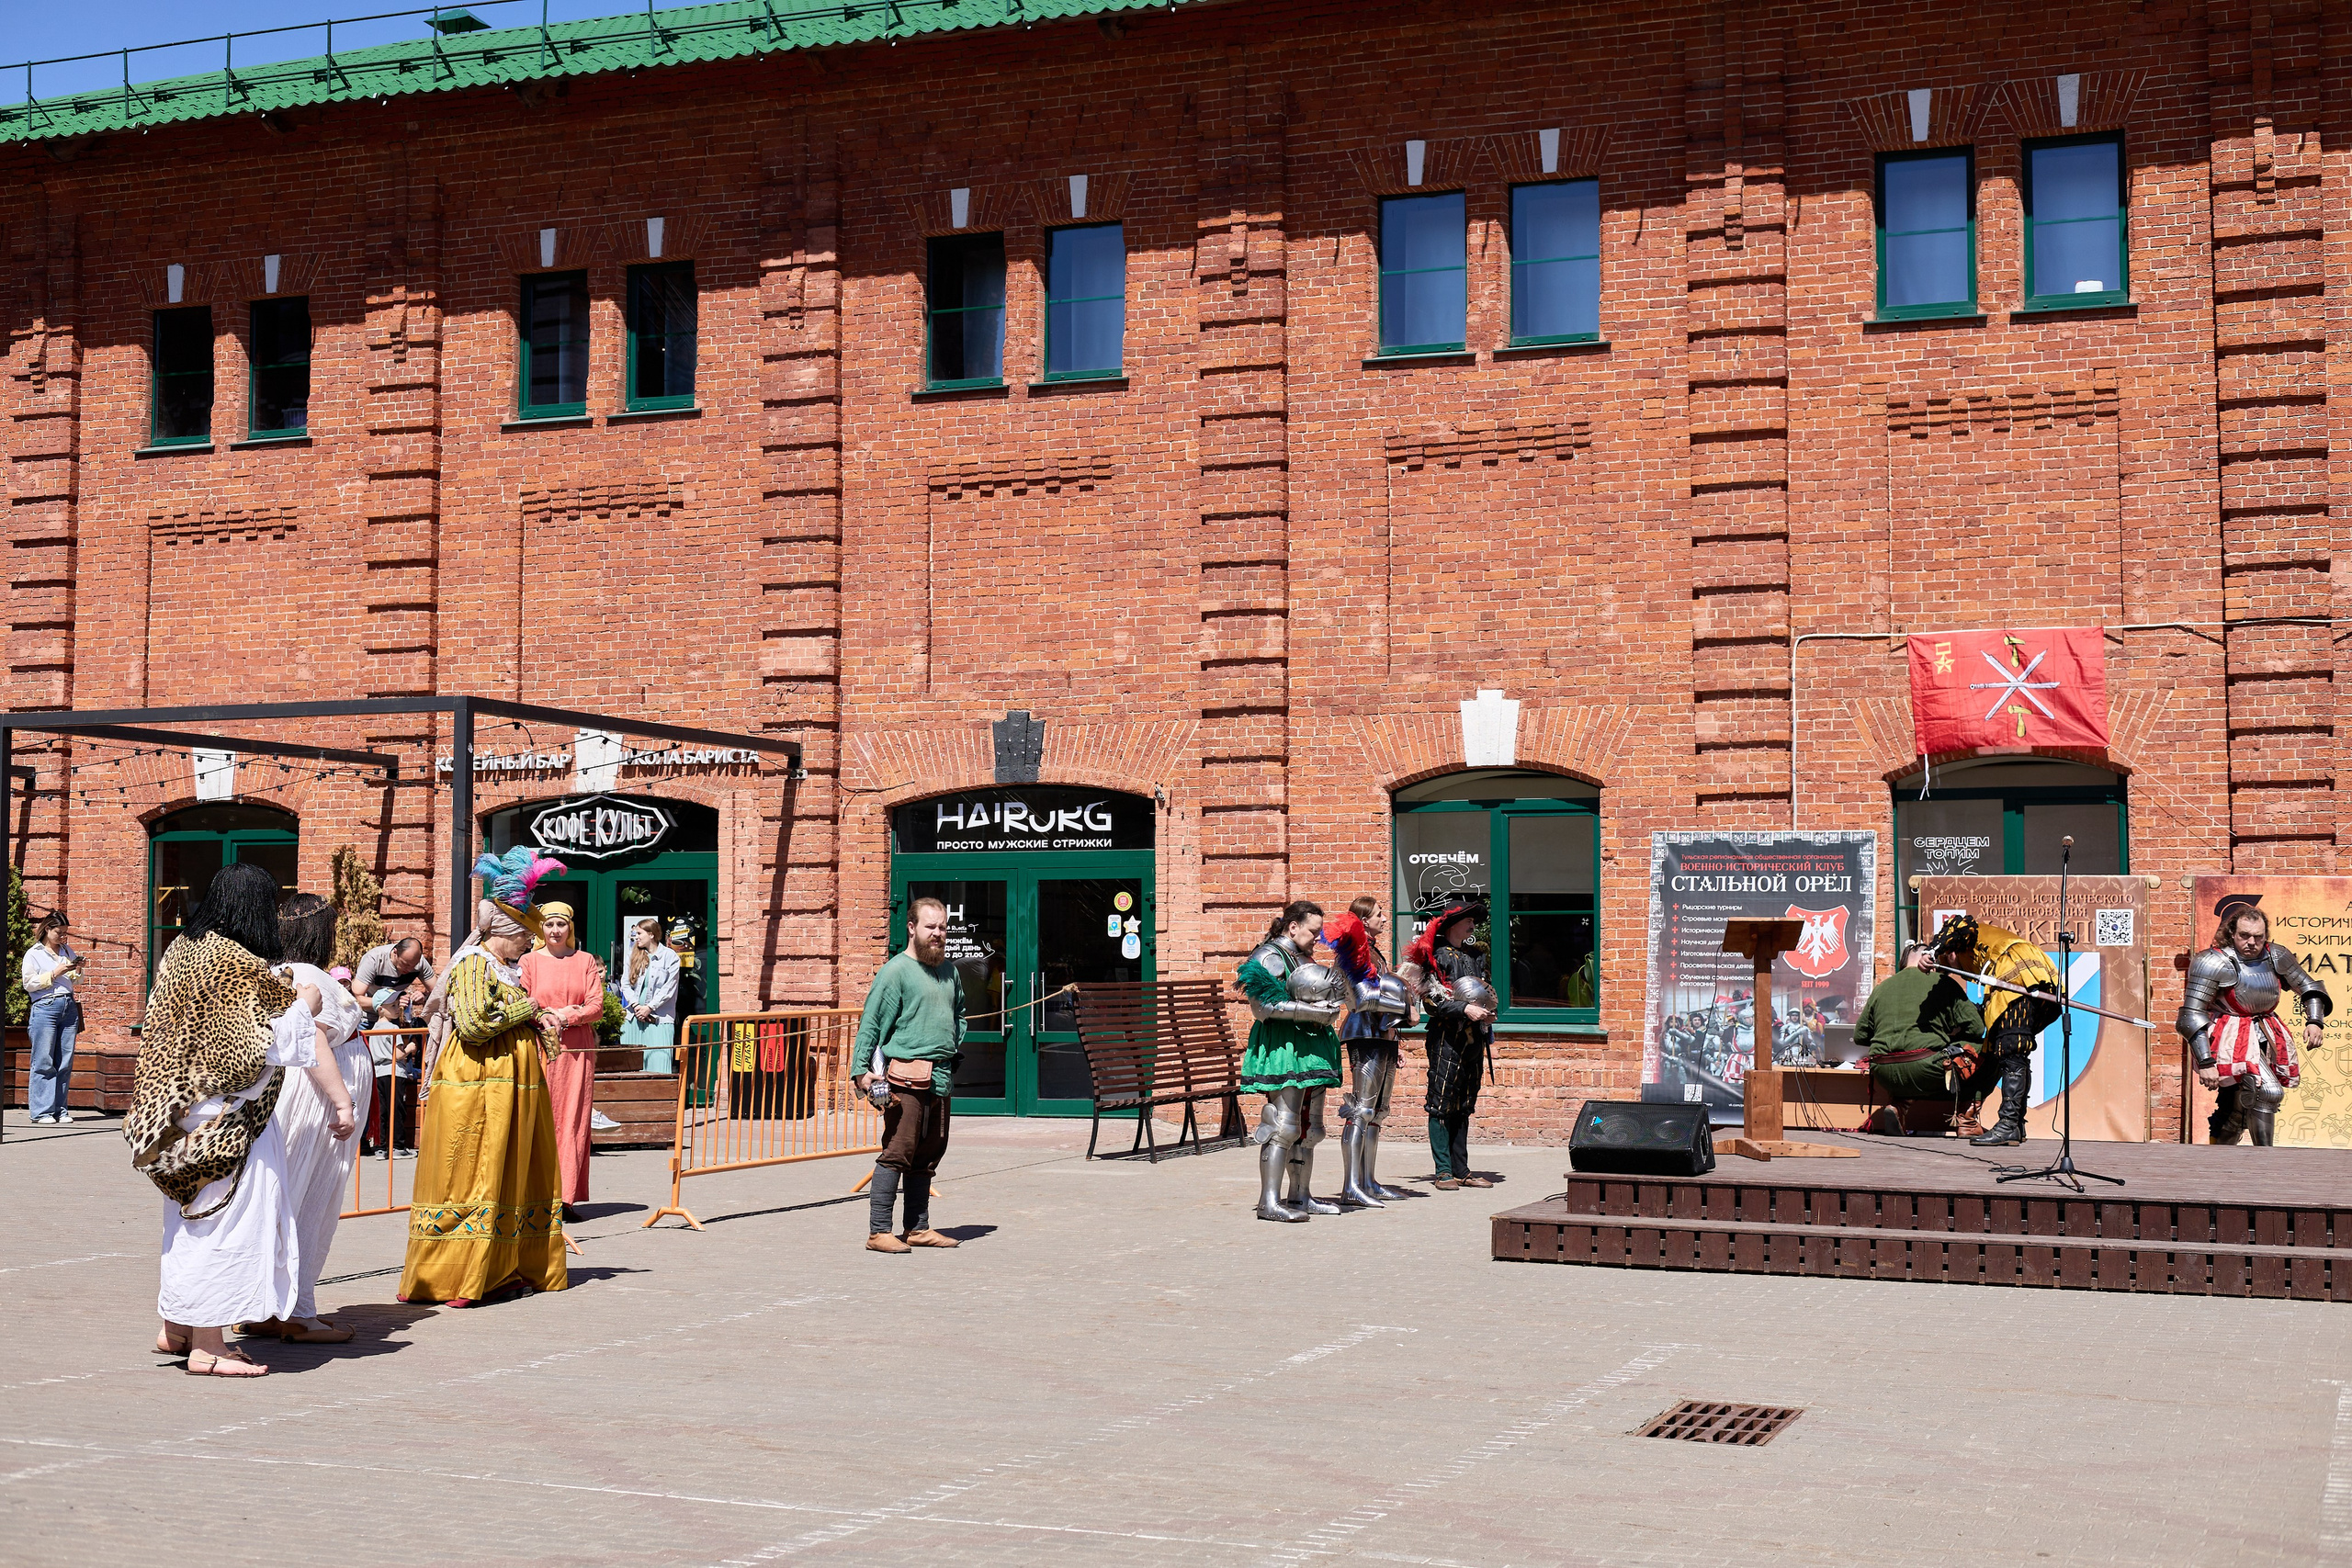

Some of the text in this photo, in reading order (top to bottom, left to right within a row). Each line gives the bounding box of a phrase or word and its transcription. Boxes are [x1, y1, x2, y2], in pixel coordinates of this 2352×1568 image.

[435, 750, 572, 772] КОЕЙНЫЙ БАР
[684, 749, 759, 764] БАРИСТА
[544, 807, 654, 847] КОФЕ КУЛЬТ
[937, 839, 1112, 850] ПРОСТО МУЖСКИЕ СТРИЖКИ
[1914, 837, 1990, 849] СЕРДЦЕМ
[1408, 851, 1479, 863] ОТСЕЧЁМ
[1924, 849, 1980, 859] ТОПИМ
[1680, 862, 1845, 872] ВОЕННО-ИСТОРИЧЕСКИЙ КЛУБ
[1671, 873, 1852, 892] СТАЛЬНОЙ ОРЁЛ
[1934, 894, 1968, 905] КЛУБ
[1971, 894, 2020, 905] ВОЕННО
[2276, 917, 2352, 928] ИСТОРИЧ
